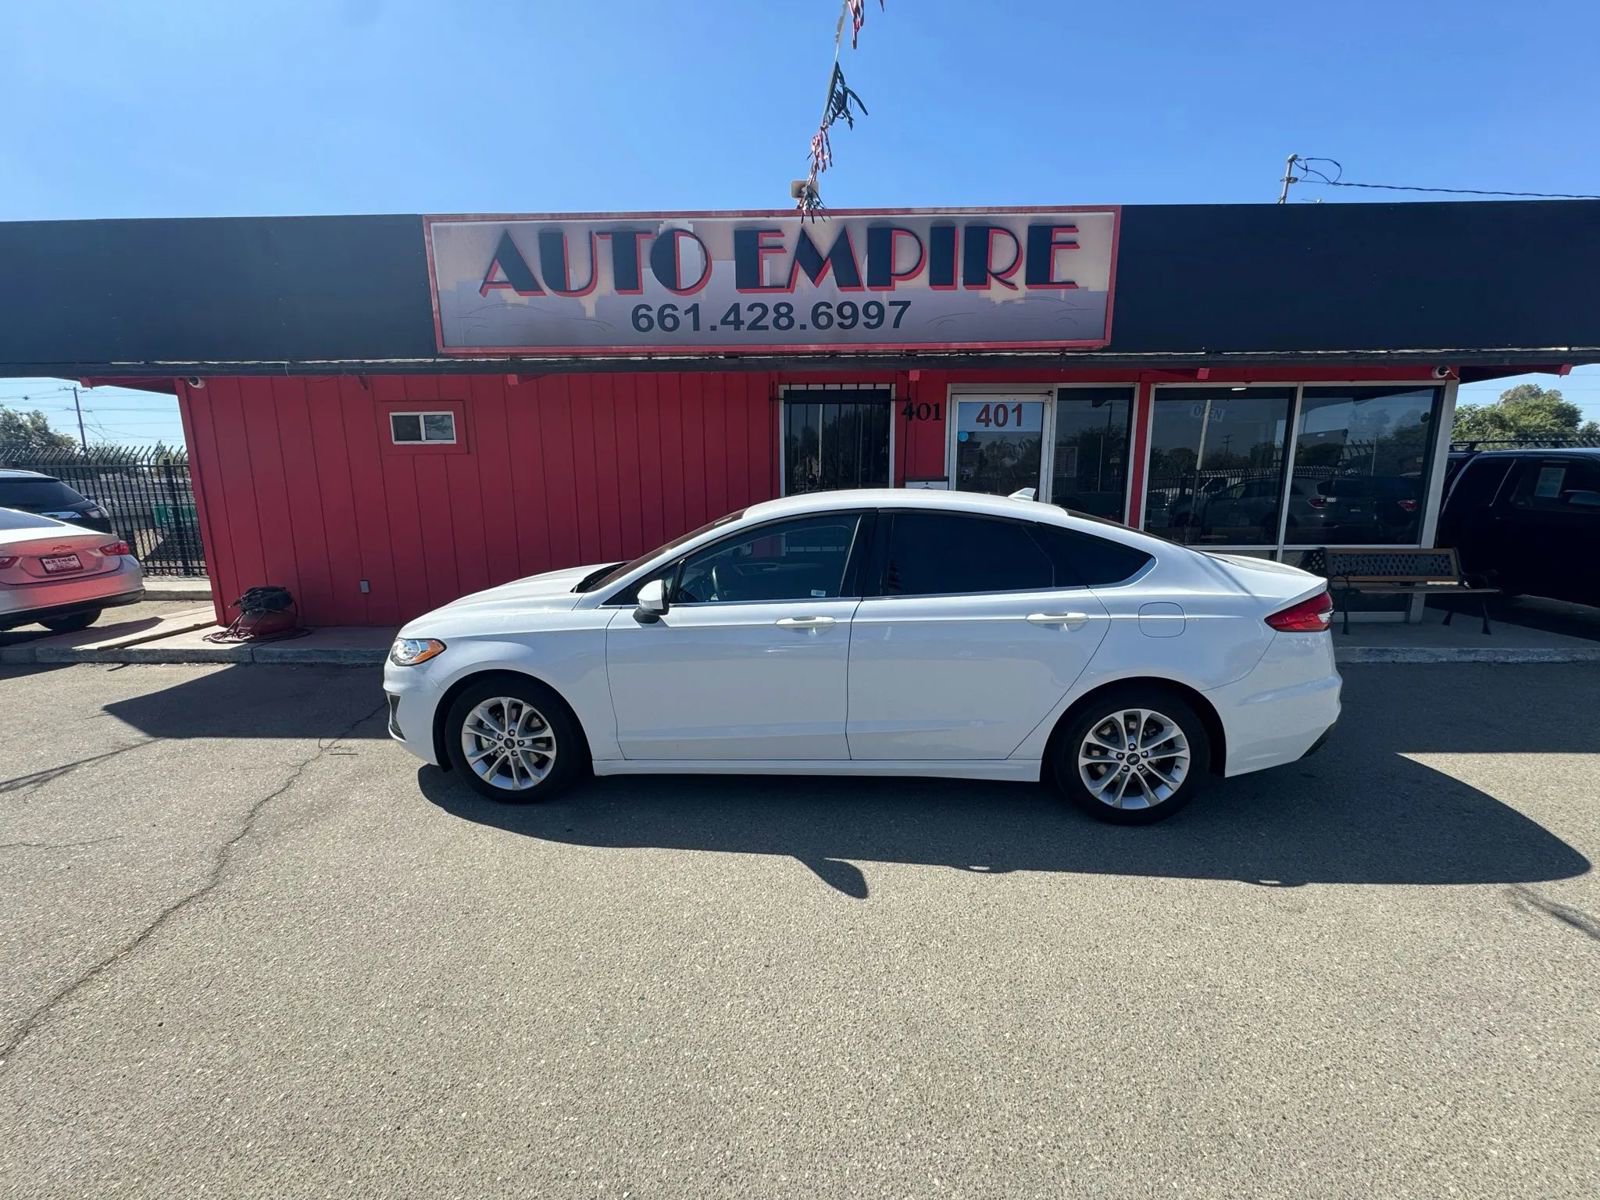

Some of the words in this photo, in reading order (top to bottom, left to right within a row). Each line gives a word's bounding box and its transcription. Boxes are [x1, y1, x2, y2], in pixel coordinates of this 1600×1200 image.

[479, 225, 713, 297] AUTO
[734, 223, 1080, 293] EMPIRE
[631, 300, 913, 332] 661.428.6997
[901, 402, 943, 421] 401
[976, 403, 1023, 427] 401
